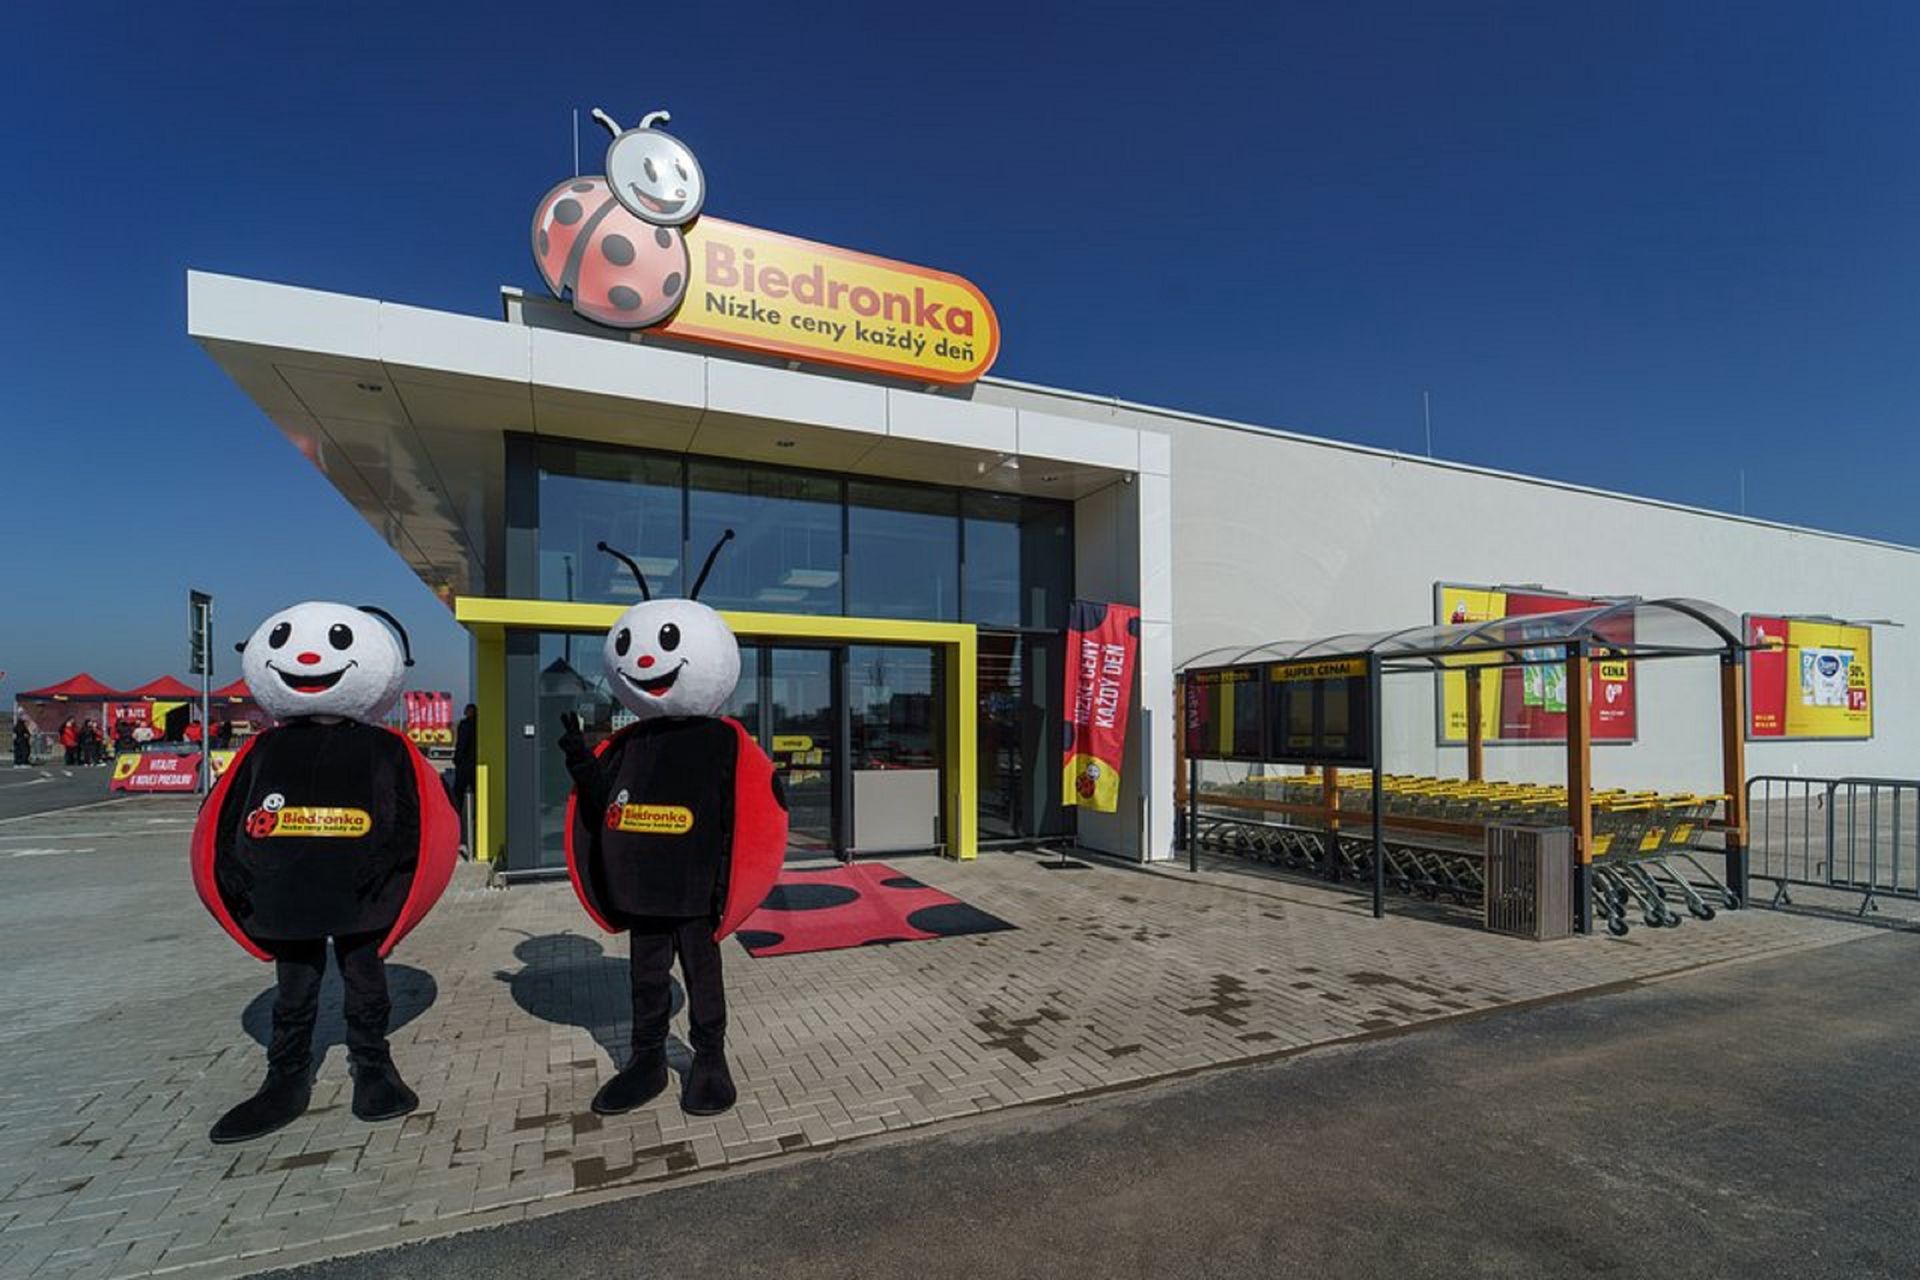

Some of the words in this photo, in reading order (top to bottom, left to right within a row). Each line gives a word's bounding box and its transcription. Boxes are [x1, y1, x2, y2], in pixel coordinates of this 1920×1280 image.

[705, 240, 974, 337] Biedronka
[705, 291, 781, 325] Nízke
[790, 314, 846, 342] ceny
[855, 320, 926, 356] každý
[934, 336, 974, 362] deň
[1079, 638, 1100, 679] CENY
[1101, 643, 1125, 675] DEŇ
[1284, 665, 1314, 678] SUPER
[1095, 676, 1120, 729] KAŽDÝ
[283, 812, 364, 825] Biedronka
